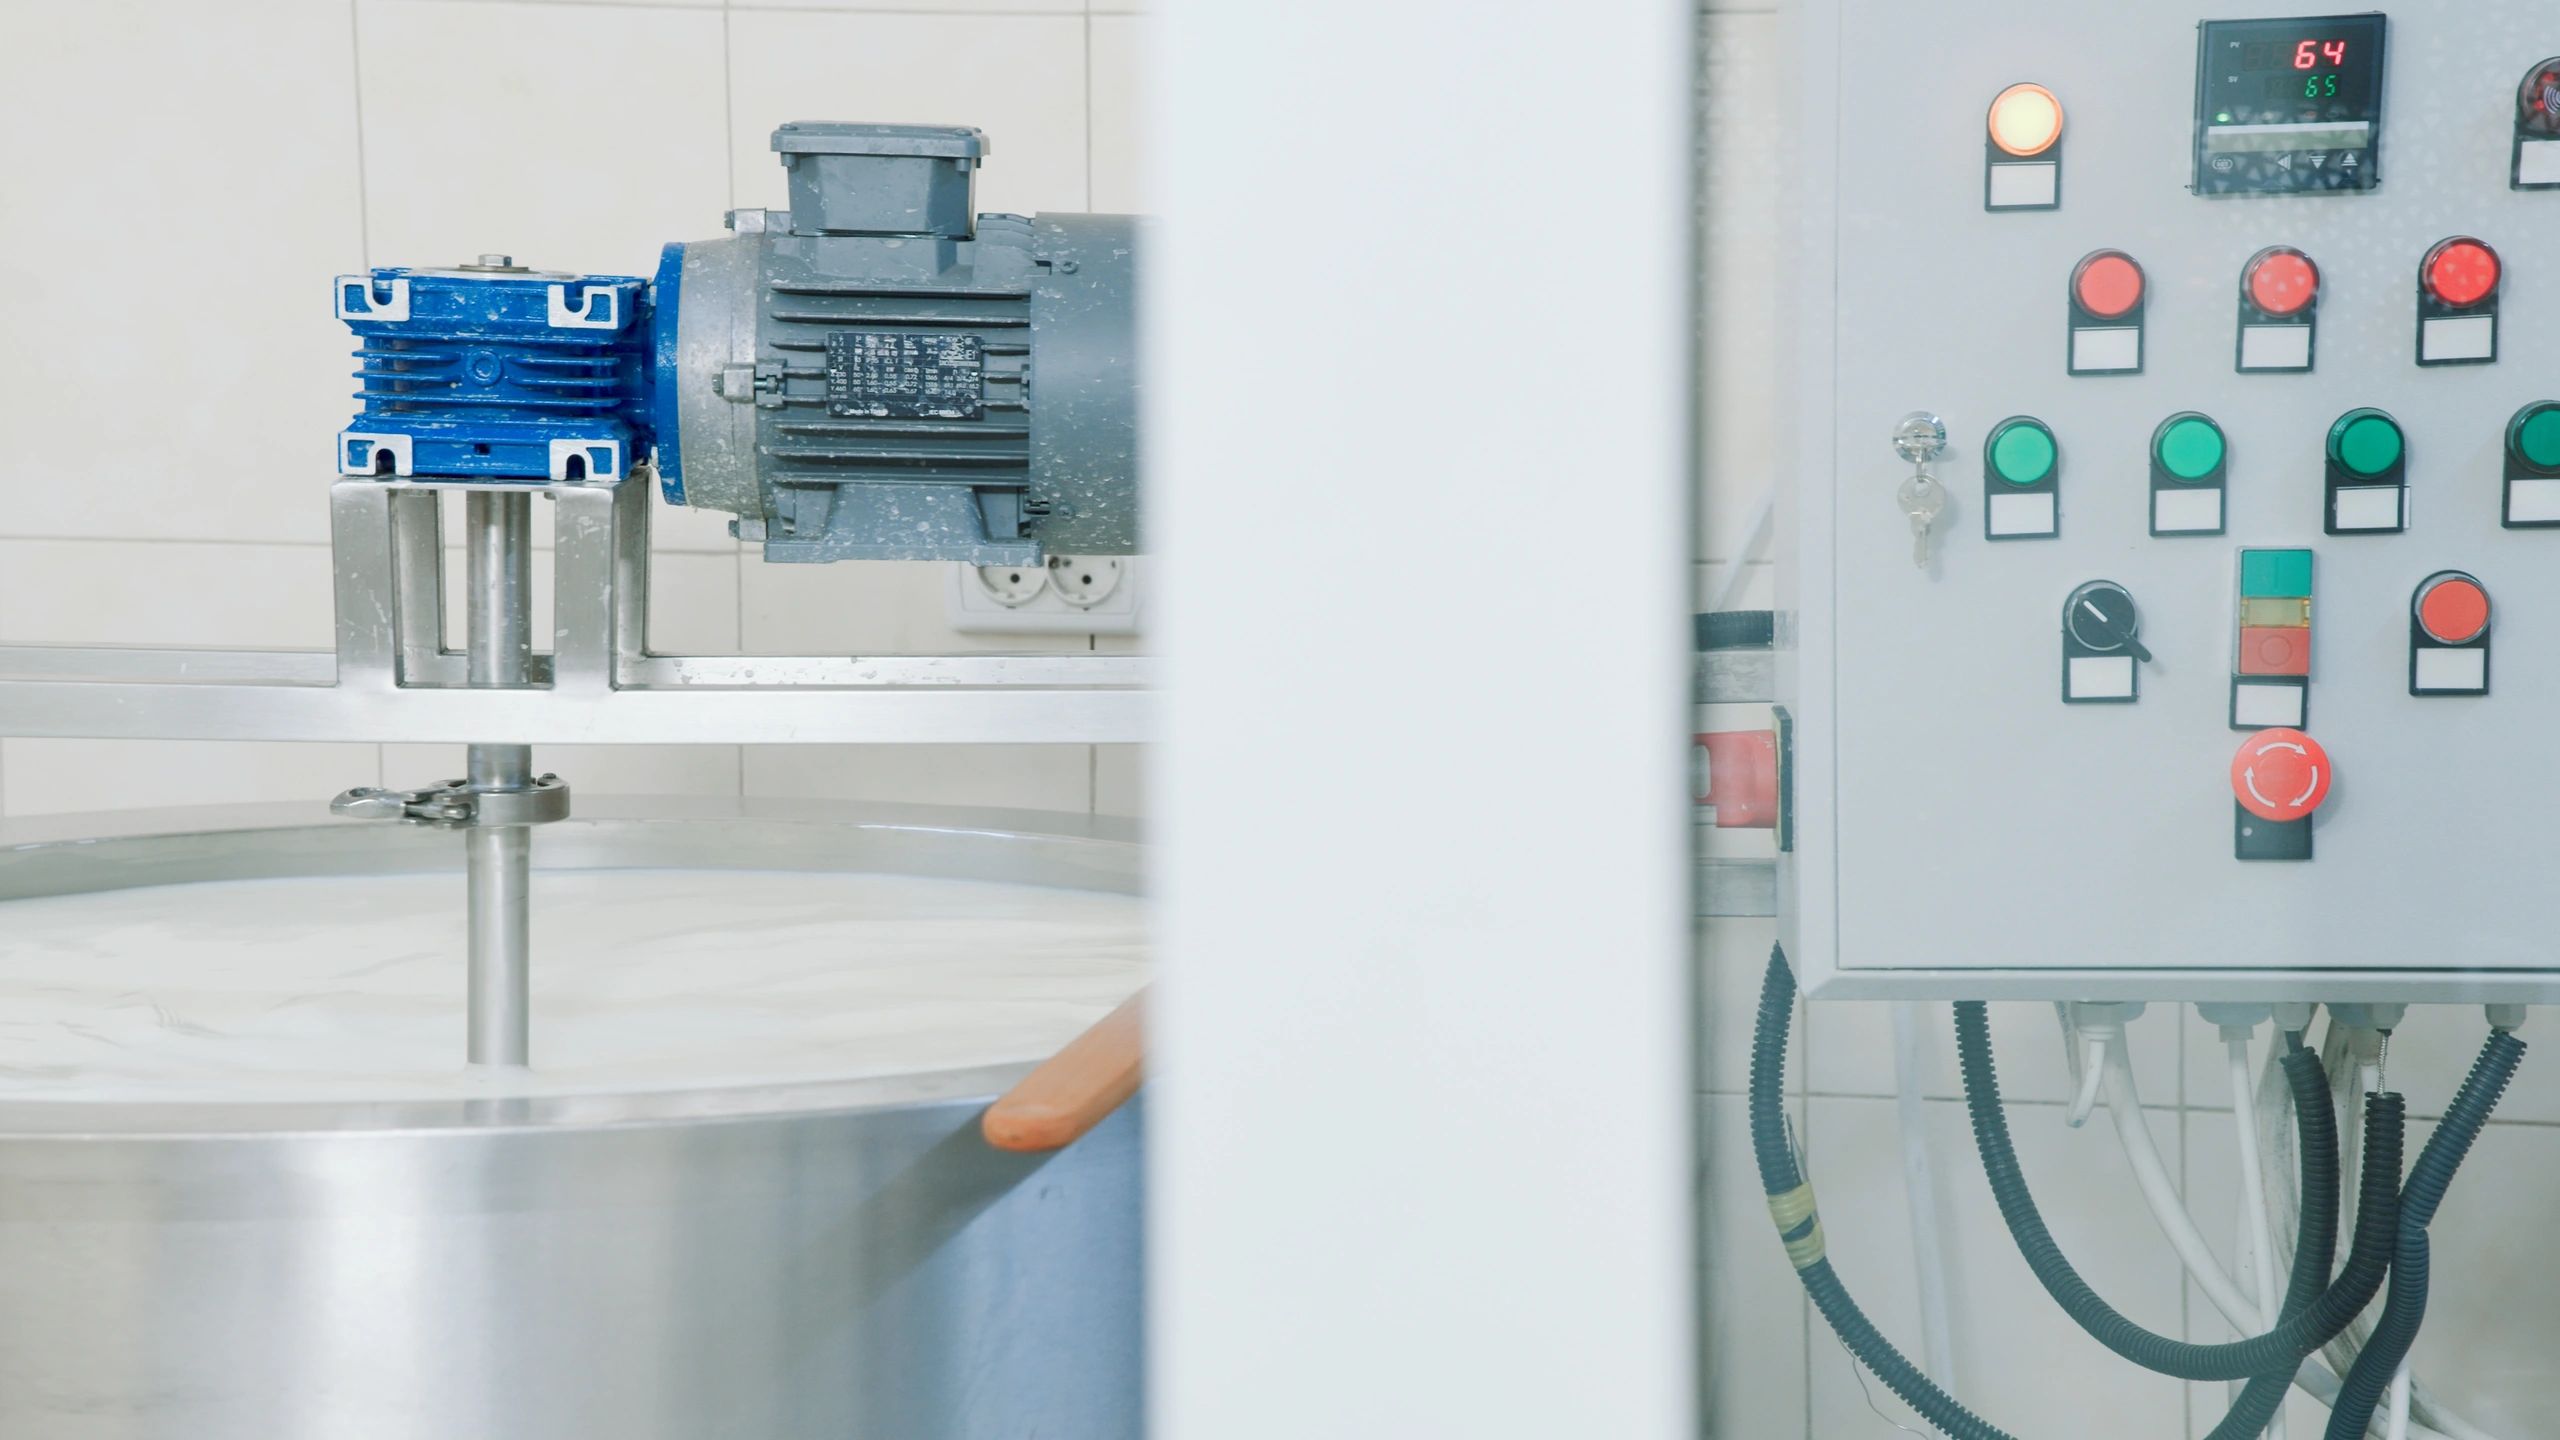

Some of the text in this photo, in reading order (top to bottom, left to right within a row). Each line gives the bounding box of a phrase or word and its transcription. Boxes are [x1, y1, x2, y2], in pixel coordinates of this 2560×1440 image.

[2229, 41, 2241, 49] PV
[2294, 40, 2345, 69] 64
[2227, 75, 2239, 83] SV
[2305, 74, 2336, 97] 65
